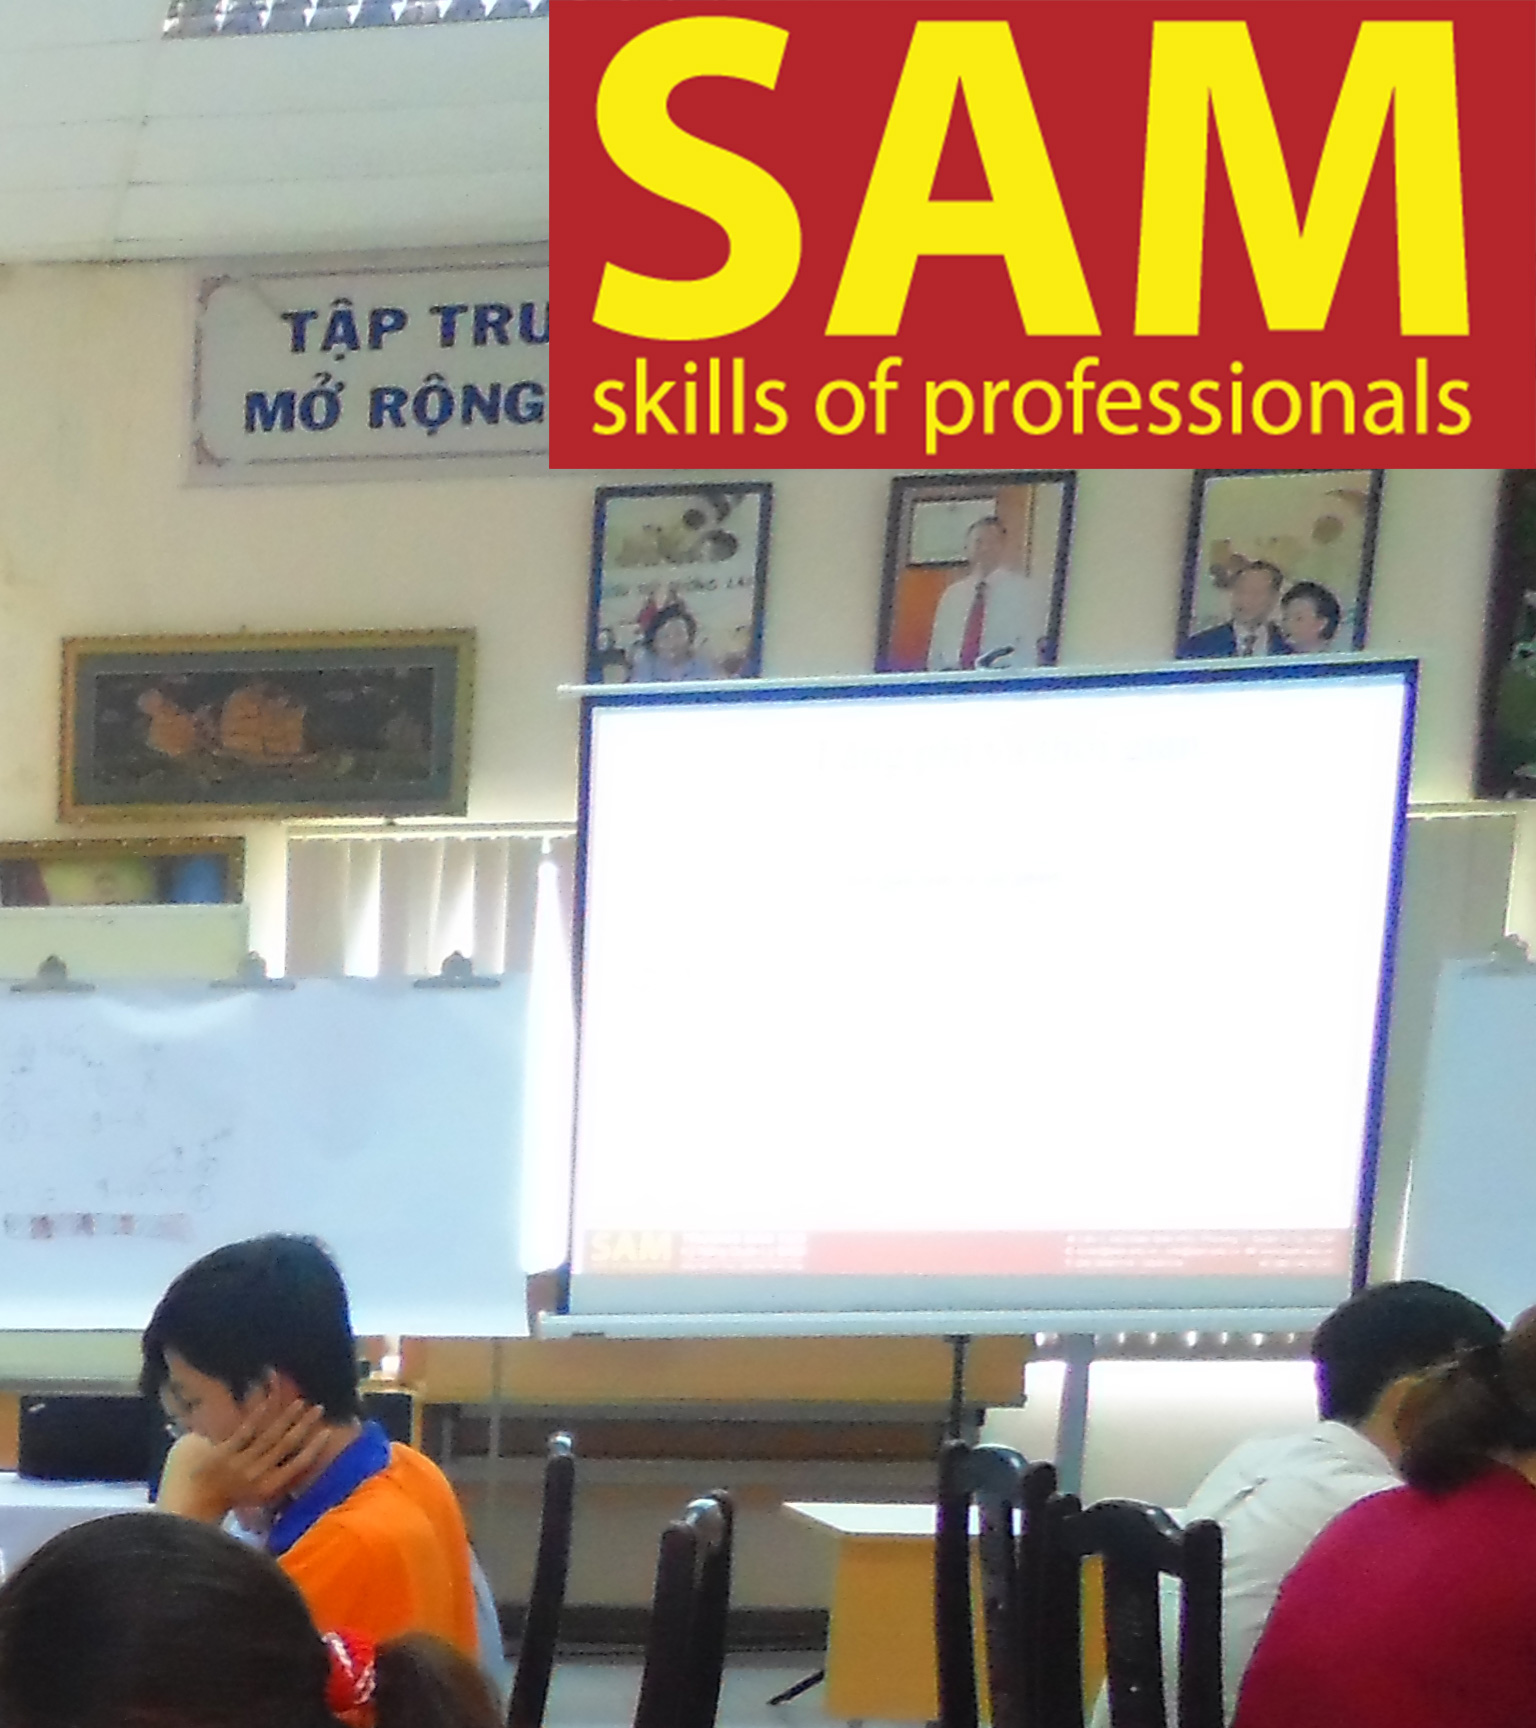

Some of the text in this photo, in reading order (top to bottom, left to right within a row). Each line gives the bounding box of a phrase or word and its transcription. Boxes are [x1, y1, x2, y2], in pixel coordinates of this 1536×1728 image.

[281, 297, 408, 361] TẬP
[245, 371, 545, 437] MỞ RỘNG
